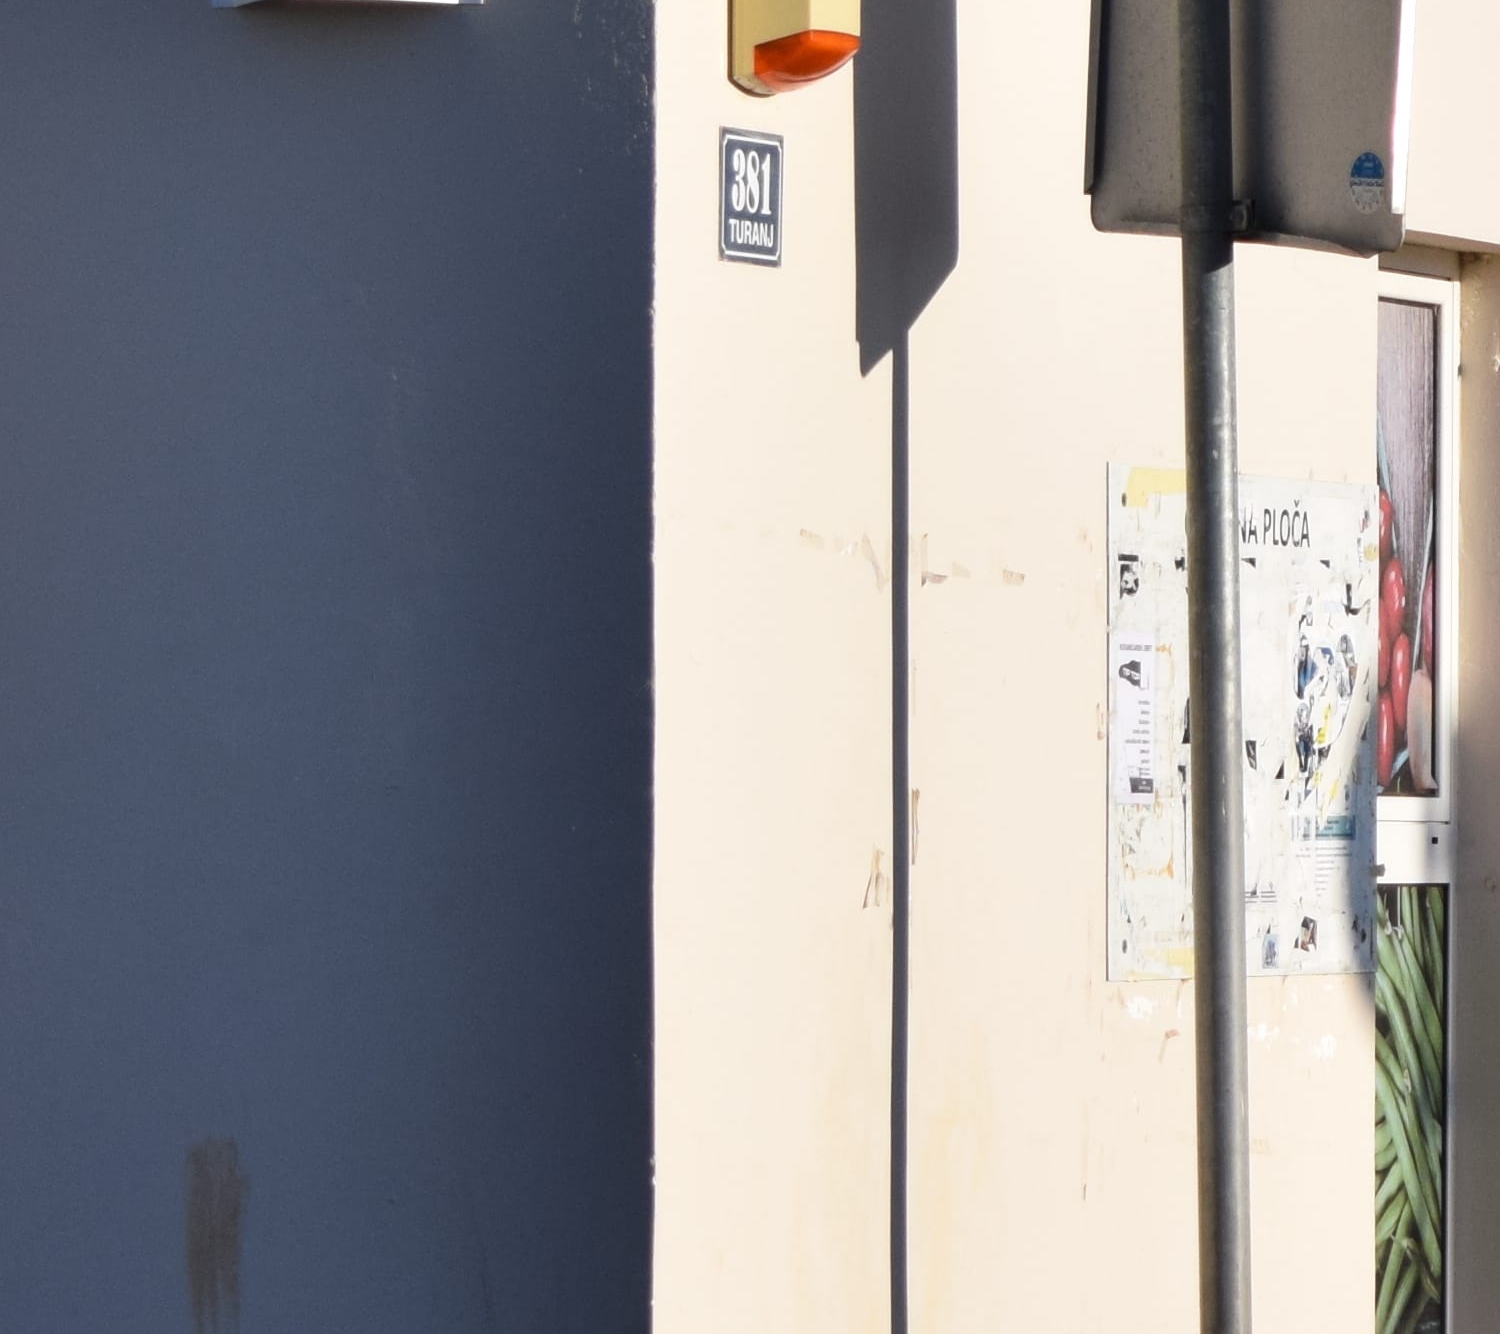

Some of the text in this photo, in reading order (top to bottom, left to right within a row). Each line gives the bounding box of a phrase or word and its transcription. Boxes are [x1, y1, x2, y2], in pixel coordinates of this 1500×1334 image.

[731, 148, 772, 215] 381
[728, 218, 774, 248] TURANJ
[1263, 499, 1310, 548] PLOČA
